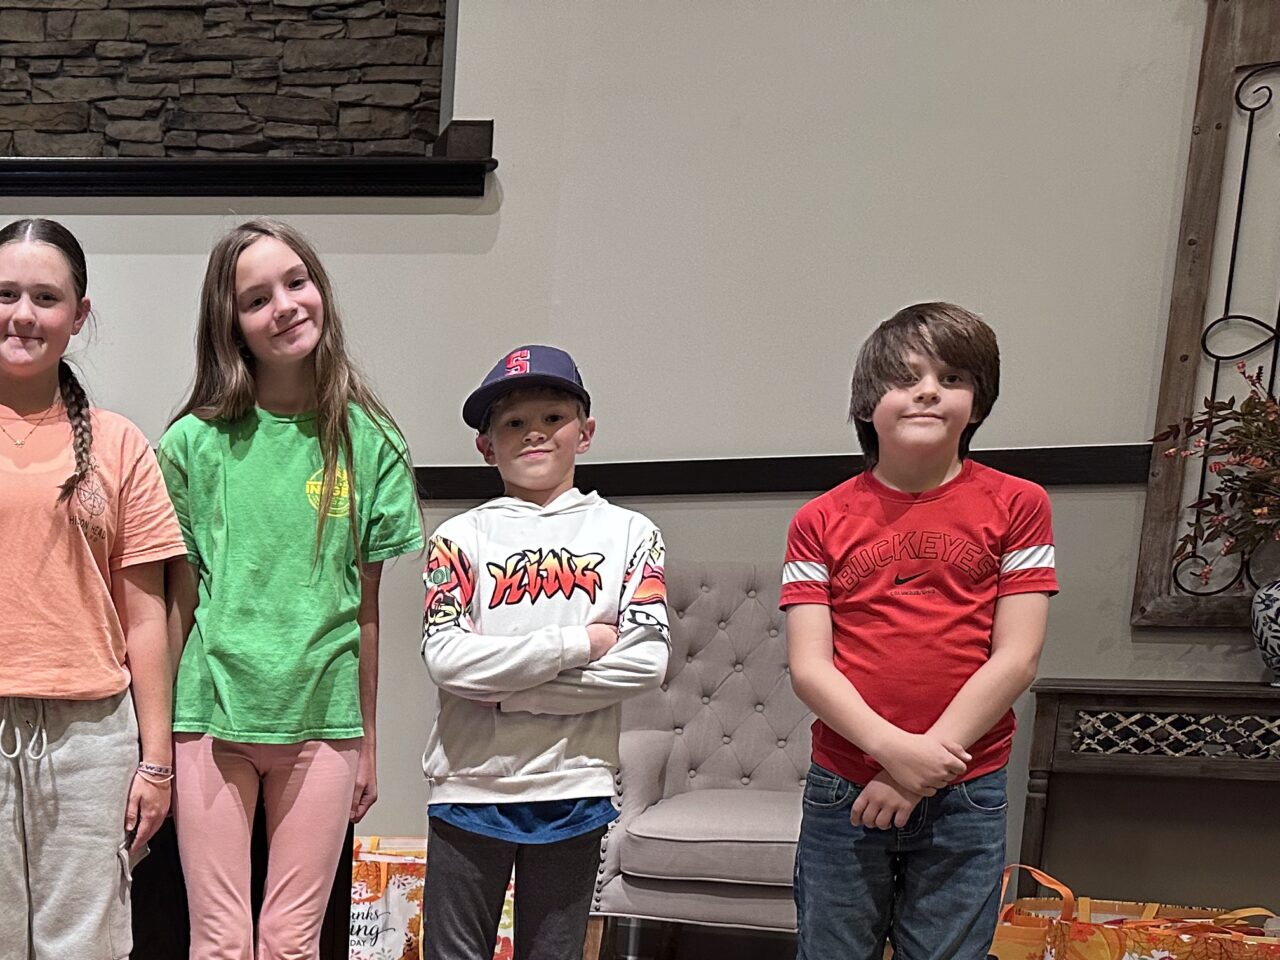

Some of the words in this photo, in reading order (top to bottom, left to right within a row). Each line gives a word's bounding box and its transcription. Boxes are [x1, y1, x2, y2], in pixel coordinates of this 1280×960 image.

[505, 350, 530, 377] S
[486, 547, 605, 609] KING
[836, 531, 1001, 592] BUCKEYES
[351, 906, 391, 921] anks
